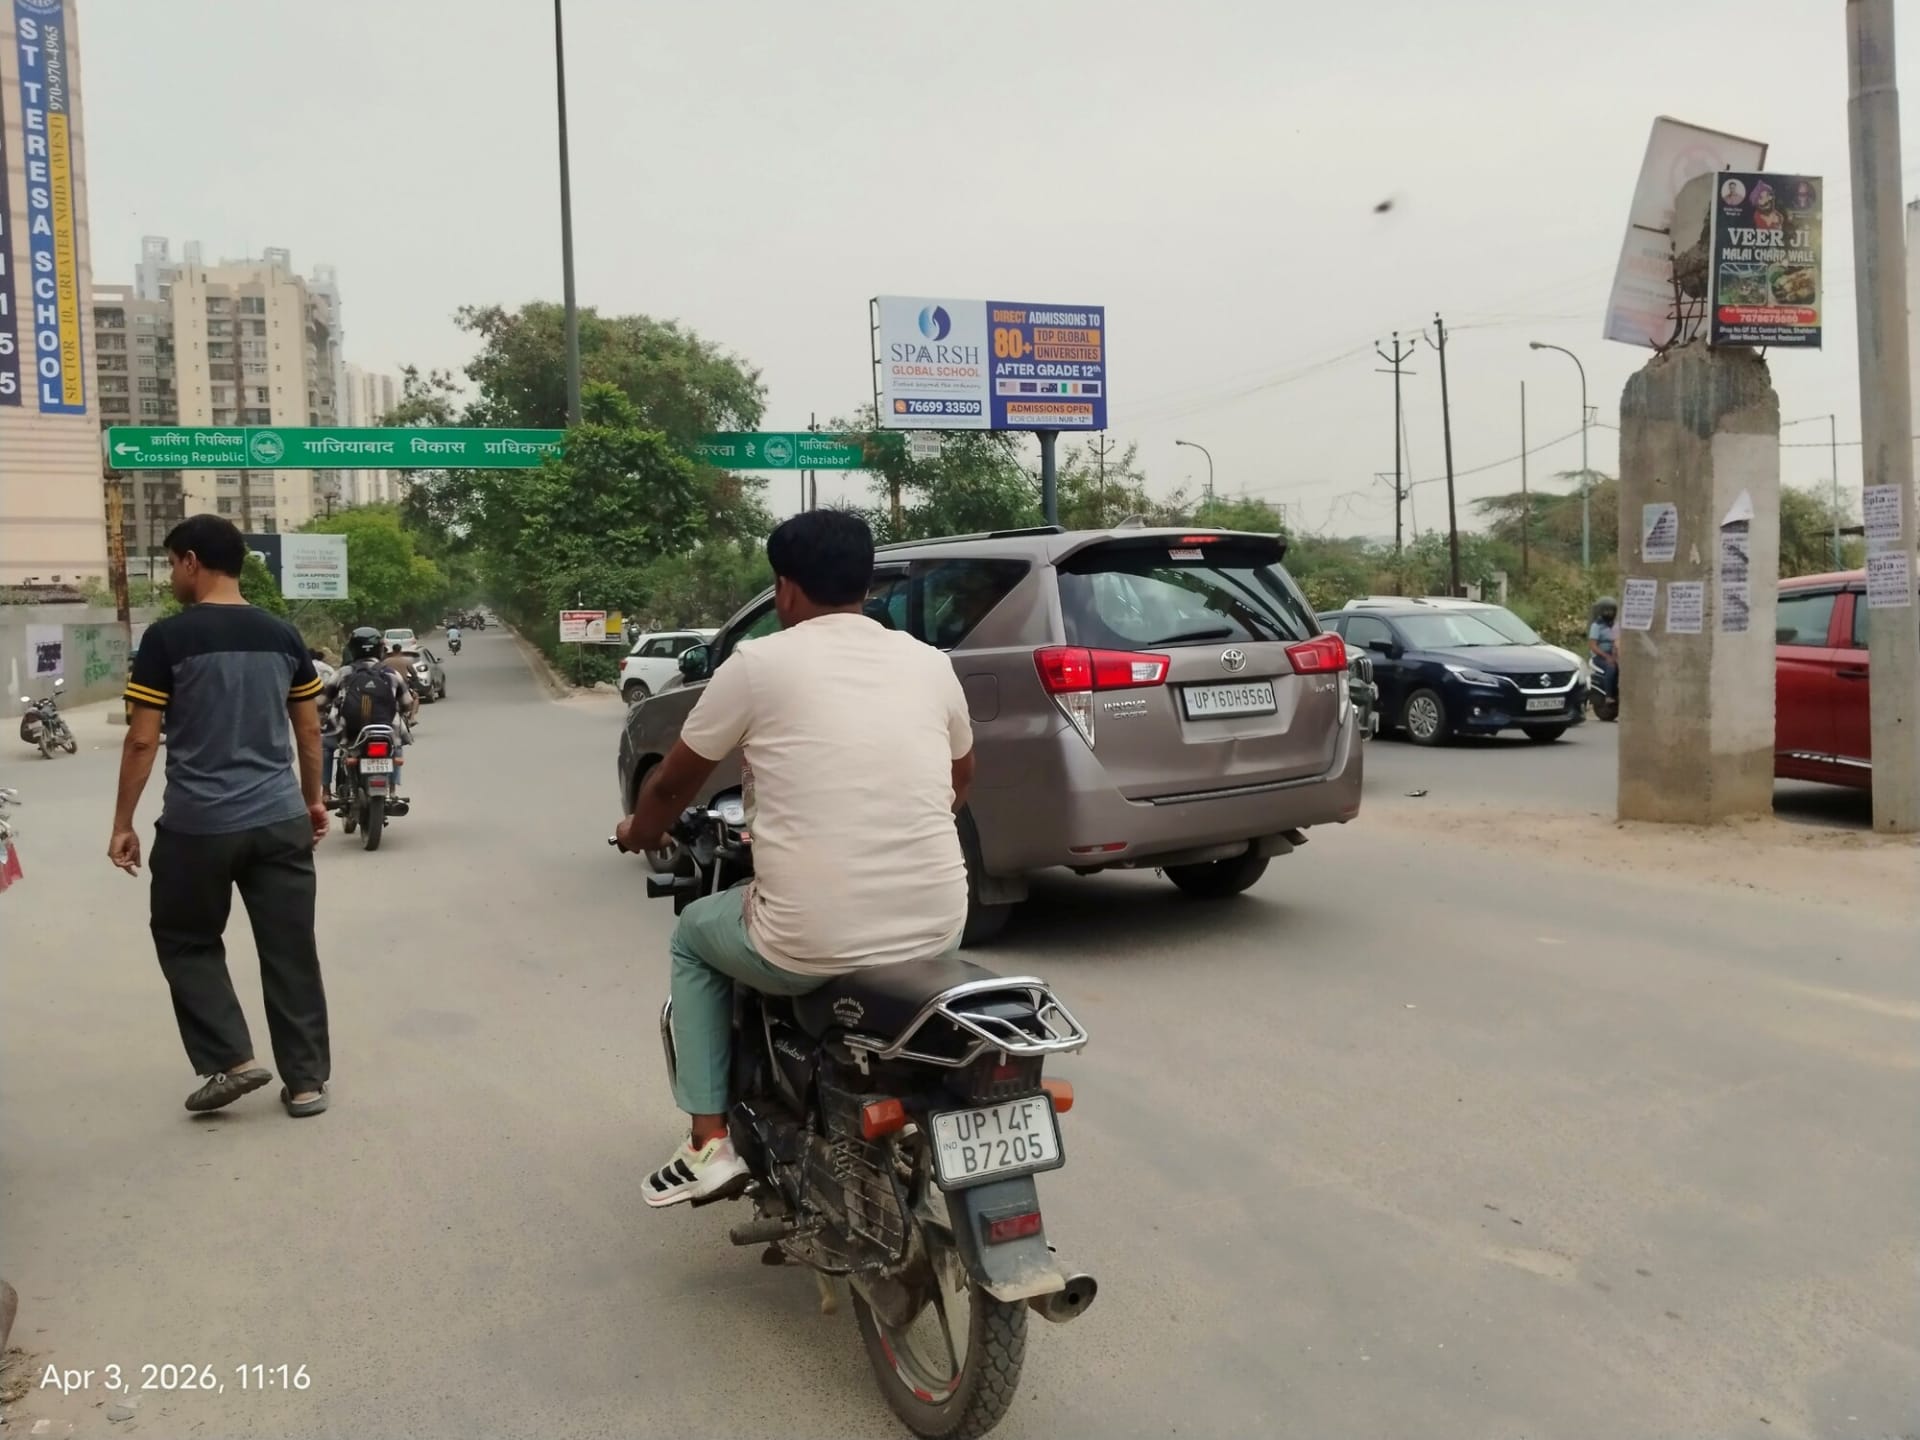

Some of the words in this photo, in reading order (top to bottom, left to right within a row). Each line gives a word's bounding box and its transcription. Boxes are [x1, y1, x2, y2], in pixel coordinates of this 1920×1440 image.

[19, 17, 39, 67] ST
[44, 24, 63, 111] 970-970-4965
[50, 116, 66, 169] (WEST)
[23, 81, 51, 235] TERESA
[54, 175, 69, 222] NOIDA
[1727, 227, 1785, 247] VEER
[56, 229, 73, 301] GREATER
[1722, 247, 1752, 261] MALAI
[1788, 249, 1814, 263] WALE
[35, 251, 60, 404] SCHOOL
[993, 309, 1026, 324] DIRECT
[1029, 311, 1087, 326] ADMISSIONS
[1089, 314, 1100, 326] TO
[1037, 329, 1054, 342] TOP
[1057, 330, 1090, 343] GLOBAL
[891, 343, 979, 365] SPARSH
[1037, 346, 1098, 360] UNIVERSITIES
[63, 340, 78, 400] SECTOR
[892, 365, 935, 377] GLOBAL
[937, 366, 981, 378] SCHOOL
[996, 363, 1035, 376] AFTER
[1037, 364, 1080, 377] GRADE
[908, 400, 943, 413] 76699
[945, 401, 980, 414] 33509
[1010, 404, 1065, 413] ADMISSIONS
[1066, 405, 1090, 413] OPEN
[303, 437, 394, 454] गाजियाबाद
[410, 437, 465, 454] विकास
[744, 441, 757, 458] है
[135, 451, 188, 464] Crossing
[192, 451, 245, 464] Republic
[1868, 561, 1894, 572] Cipla
[1194, 687, 1273, 709] UP16DH9560
[955, 1103, 1033, 1141] UP14F
[962, 1133, 1043, 1173] B7205
